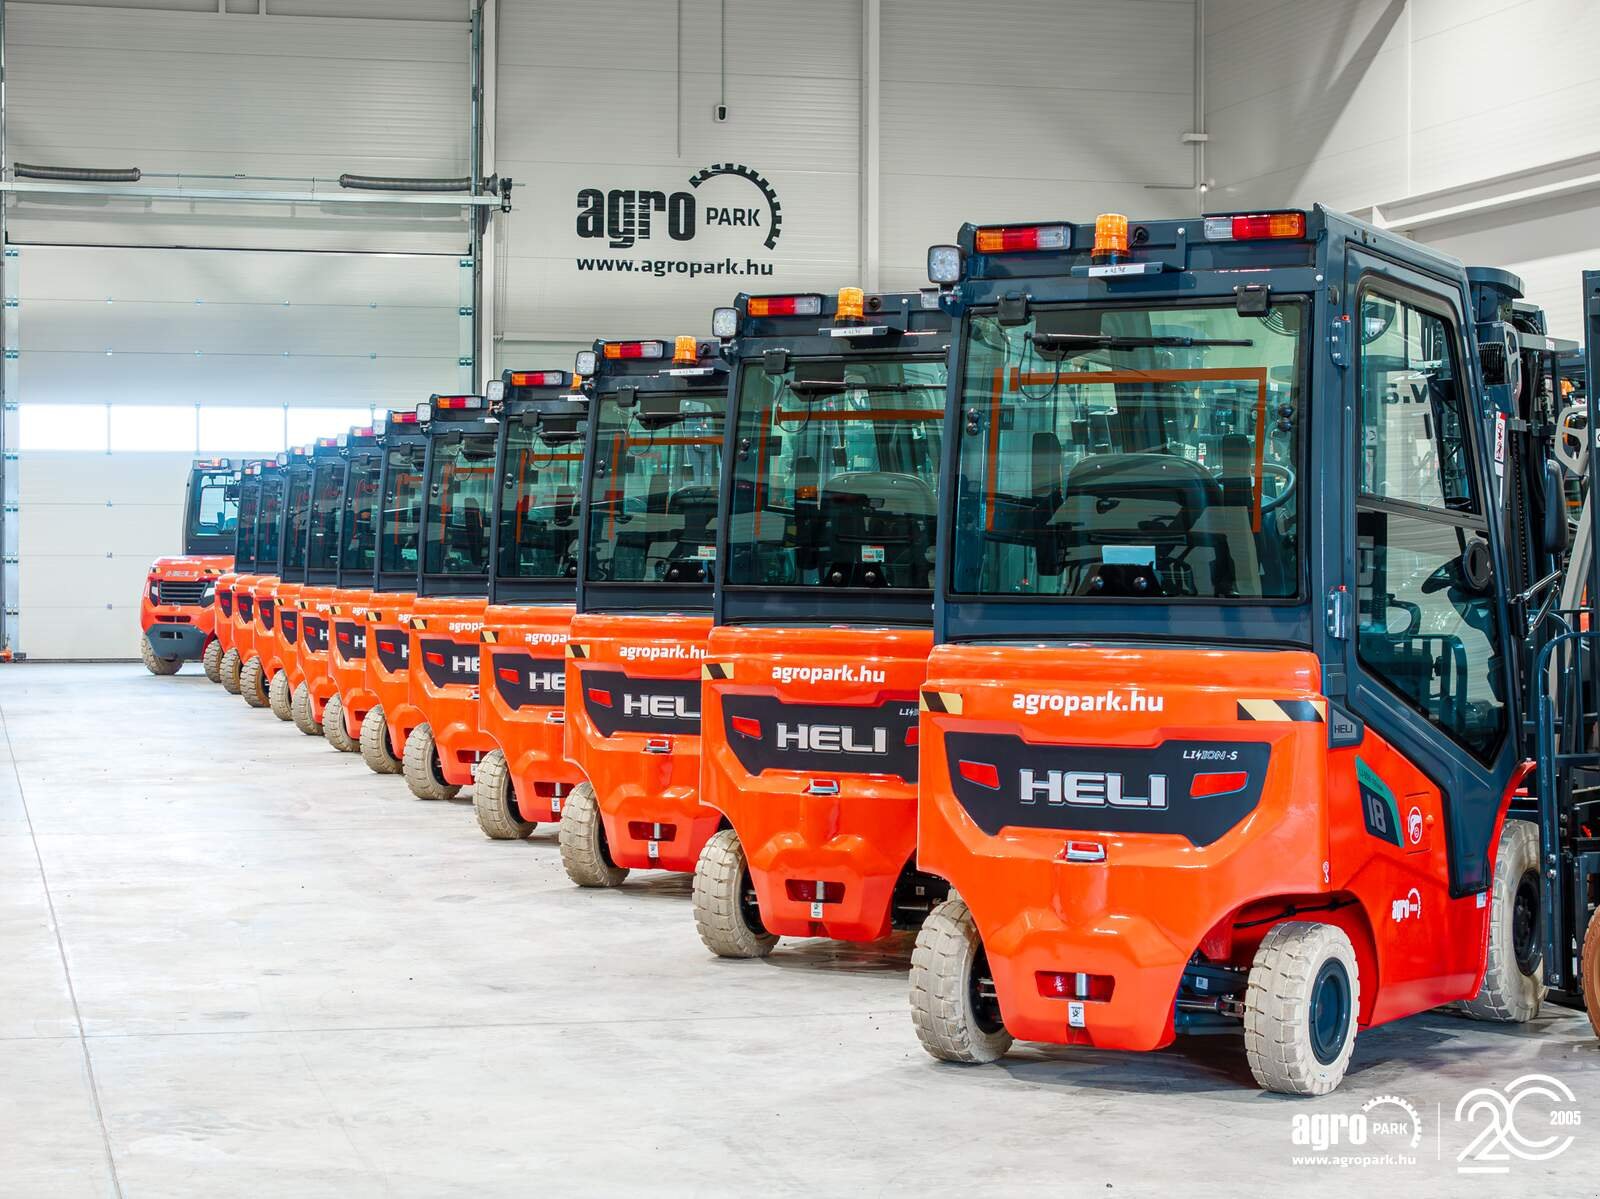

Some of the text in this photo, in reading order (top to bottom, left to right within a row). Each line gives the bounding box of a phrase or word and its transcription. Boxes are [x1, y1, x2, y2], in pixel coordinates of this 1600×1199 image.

[576, 188, 761, 249] agro PARK
[576, 257, 774, 278] www.agropark.hu
[771, 664, 886, 684] agropark.hu
[1011, 690, 1164, 717] agropark.hu
[776, 722, 889, 756] HELI
[1334, 723, 1353, 734] HELI
[1018, 768, 1170, 811] HELI
[1366, 792, 1388, 834] 18
